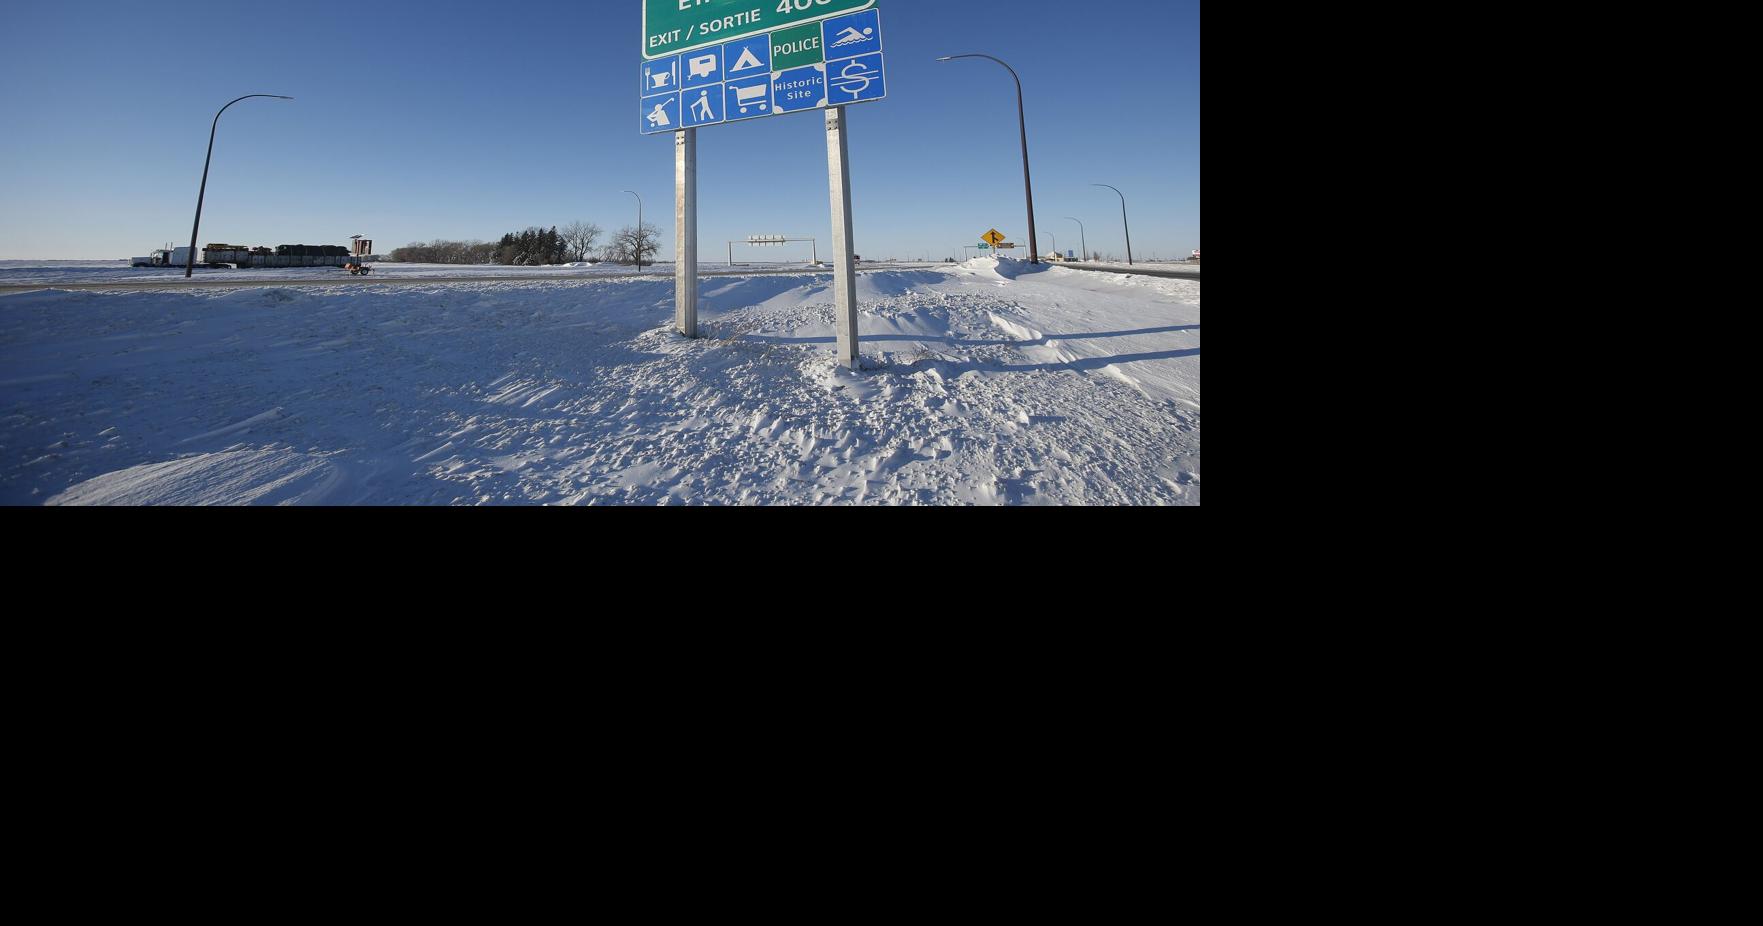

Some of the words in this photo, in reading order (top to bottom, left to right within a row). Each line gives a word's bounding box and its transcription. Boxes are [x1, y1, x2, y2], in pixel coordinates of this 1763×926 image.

[649, 29, 681, 48] EXIT
[686, 25, 695, 41] /
[699, 8, 761, 35] SORTIE
[776, 0, 832, 14] 40
[773, 36, 820, 57] POLICE
[775, 77, 823, 92] Historic
[787, 90, 811, 100] Site
